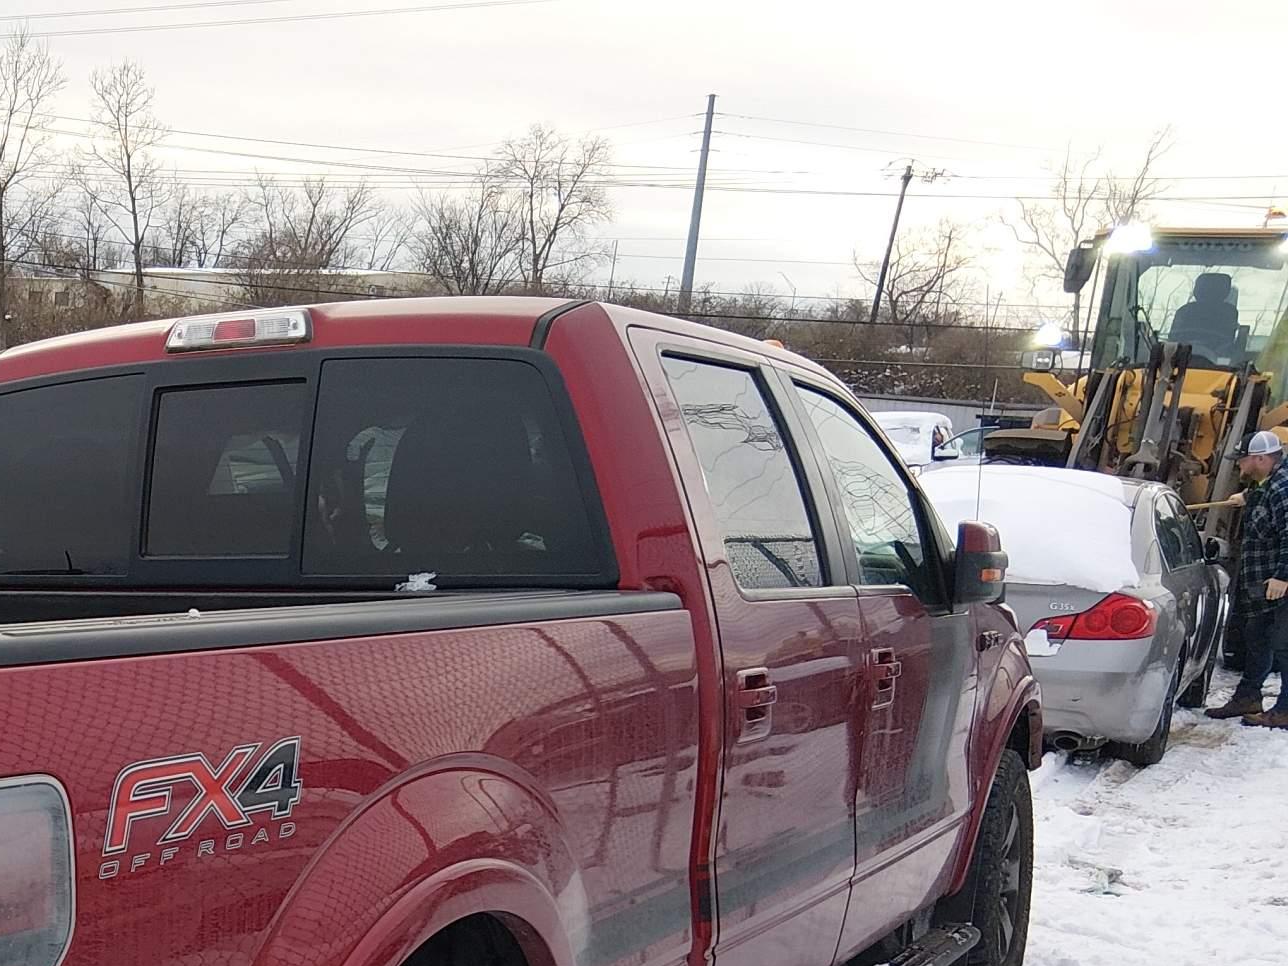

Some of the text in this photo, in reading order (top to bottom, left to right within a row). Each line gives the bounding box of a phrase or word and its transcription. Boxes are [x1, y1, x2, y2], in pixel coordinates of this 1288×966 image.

[102, 736, 303, 857] FX4
[98, 822, 296, 879] OFF ROAD
